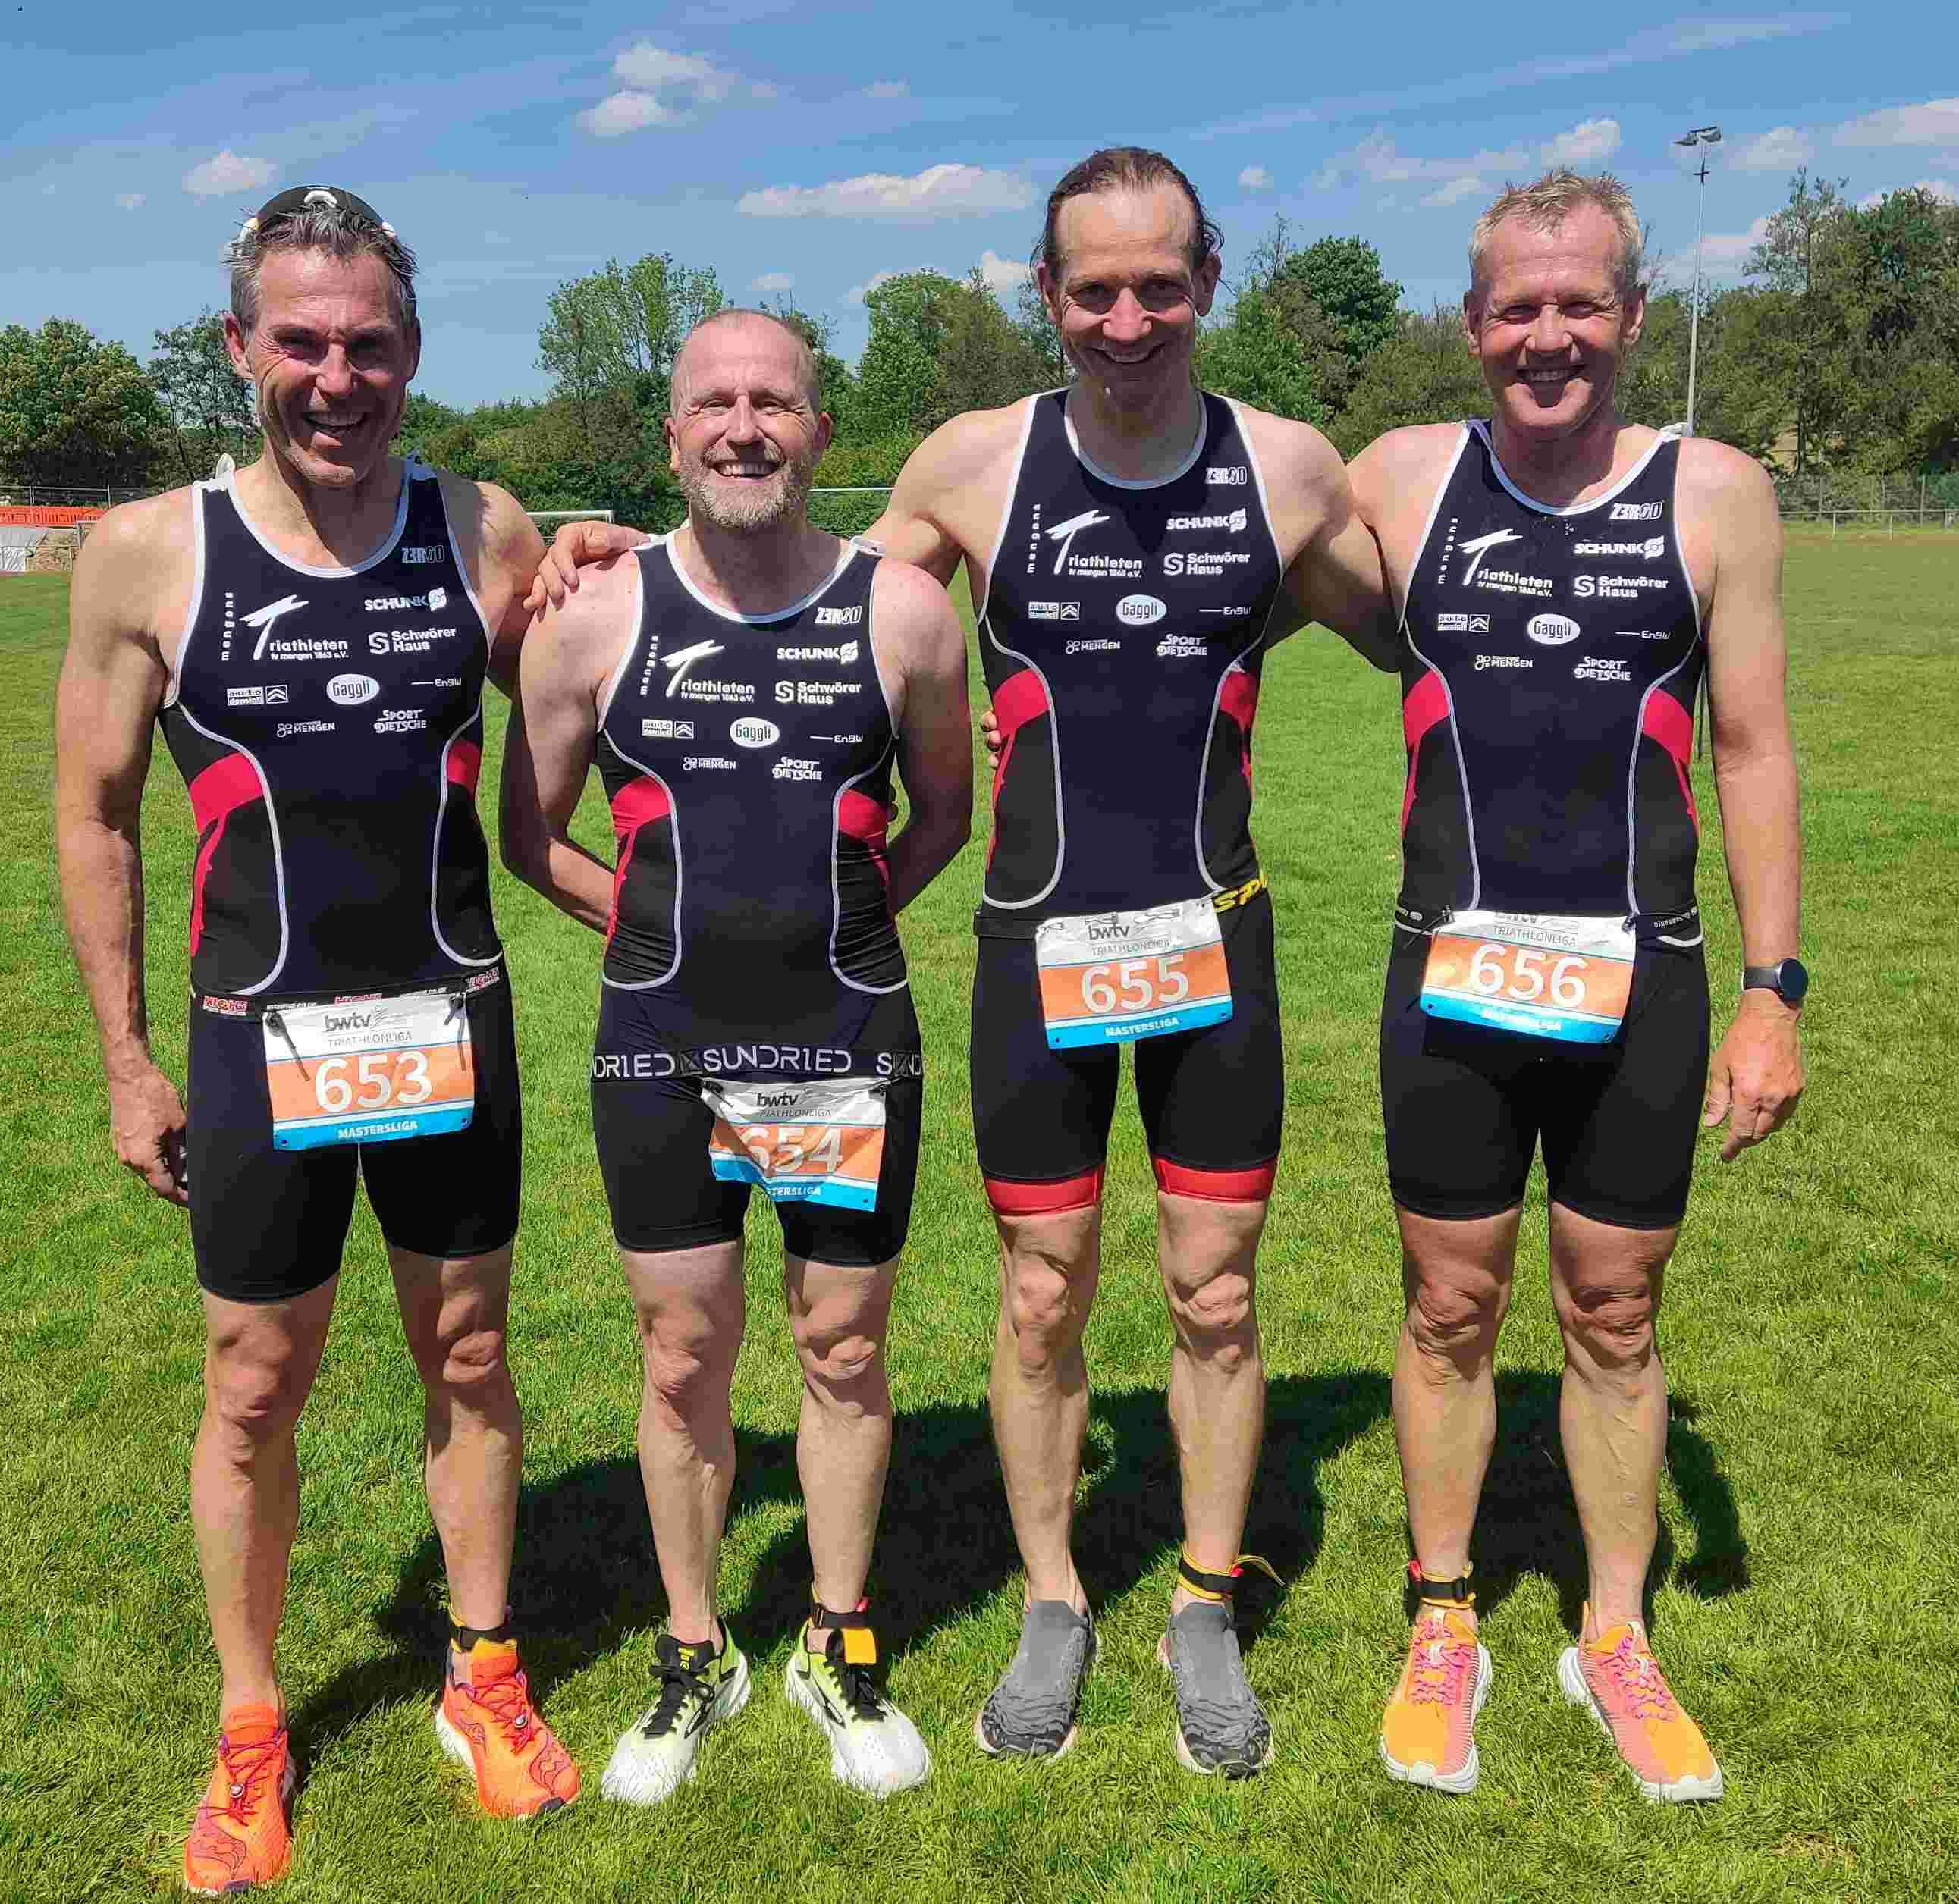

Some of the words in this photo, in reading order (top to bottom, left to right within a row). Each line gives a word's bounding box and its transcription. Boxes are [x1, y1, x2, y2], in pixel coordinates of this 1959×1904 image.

[1166, 517, 1229, 530] SCHUNK
[1574, 542, 1644, 554] SCHUNK
[1187, 552, 1250, 563] Schwörer
[1186, 563, 1223, 575] Haus
[1598, 576, 1669, 589] Schwörer
[1598, 586, 1638, 598] Haus
[364, 594, 429, 610] SCHUNK
[1122, 602, 1157, 619] Gaggli
[391, 627, 457, 641] Schwörer
[1534, 621, 1571, 638] Gaggli
[393, 640, 430, 652] Haus
[777, 647, 840, 660] SCHUNK
[1081, 641, 1120, 651] MENGEN
[1491, 659, 1533, 668] MENGEN
[332, 681, 371, 698] Gaggli
[797, 682, 862, 693] Schwörer
[797, 692, 834, 704] Haus
[294, 722, 335, 733] MENGEN
[735, 724, 771, 742] Gaggli
[698, 759, 736, 770] MENGEN
[1088, 924, 1129, 941] bwtv
[1493, 925, 1577, 946] TRIATHLONLIGA
[1468, 944, 1589, 1008] 656
[1082, 956, 1190, 1014] 655
[324, 1012, 372, 1032] bwtv
[1104, 1017, 1179, 1037] MASTERSLIGA
[327, 1031, 413, 1048] TRIATHLONLIGA
[703, 1045, 851, 1072] SUNDRIED
[314, 1051, 432, 1112] 653
[757, 1092, 799, 1107] bwtv
[337, 1120, 418, 1139] MASTERSLIGA
[741, 1126, 843, 1174] 654
